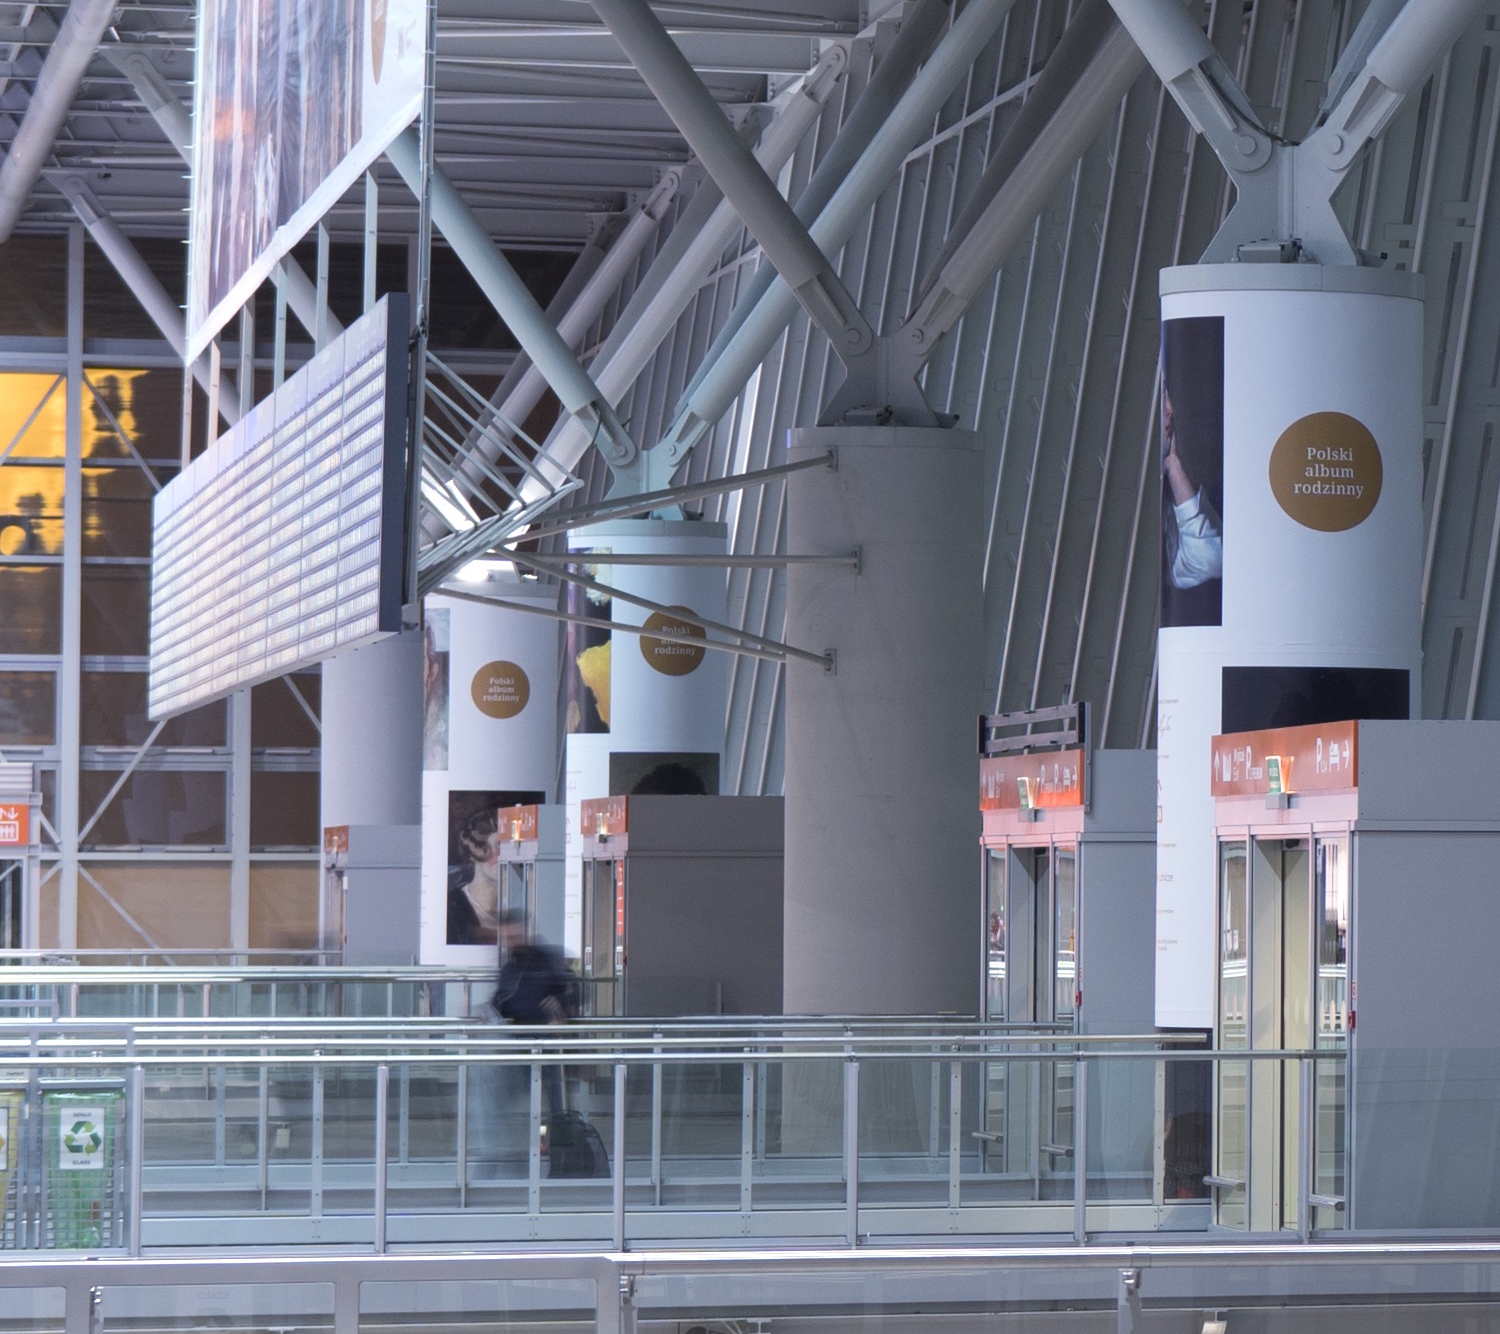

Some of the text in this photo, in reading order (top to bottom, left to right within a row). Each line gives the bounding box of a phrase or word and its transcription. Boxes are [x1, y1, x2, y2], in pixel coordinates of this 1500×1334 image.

[1306, 447, 1354, 462] Polski
[1305, 463, 1355, 479] album
[1293, 481, 1364, 499] rodzinny
